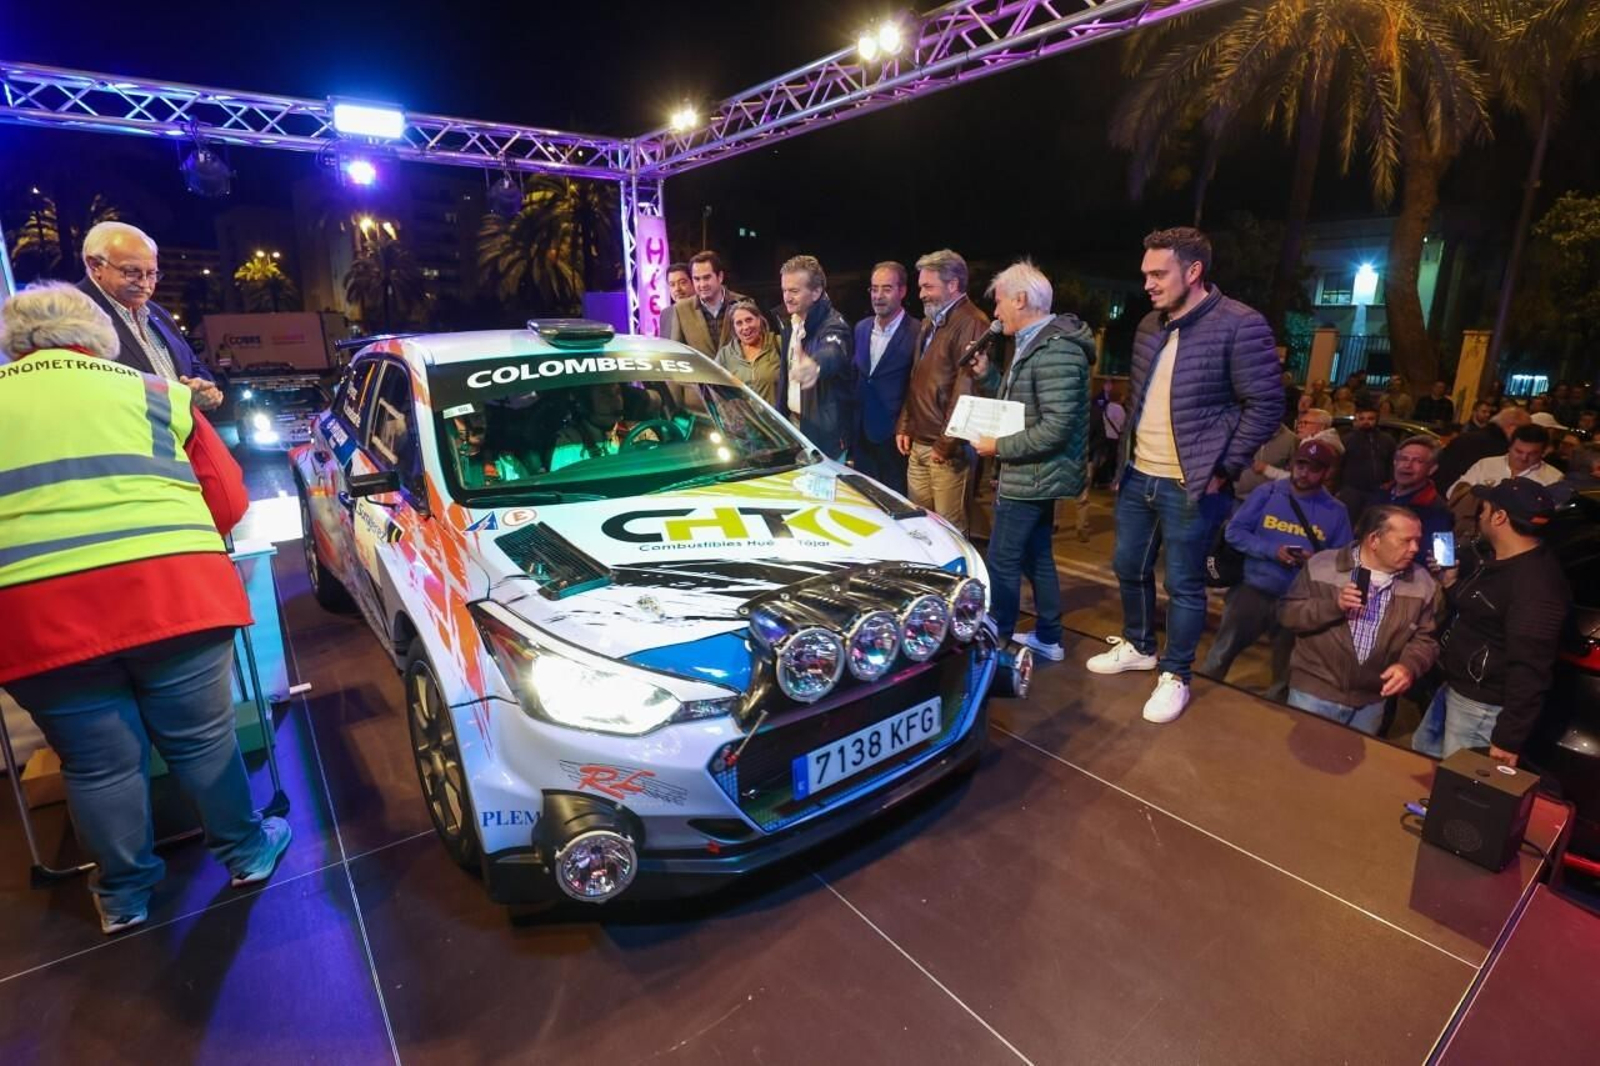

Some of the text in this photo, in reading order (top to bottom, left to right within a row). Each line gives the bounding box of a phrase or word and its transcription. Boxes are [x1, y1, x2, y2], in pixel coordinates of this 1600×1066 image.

[466, 357, 694, 389] COLOMBES.ES
[638, 538, 742, 551] Combustibles
[815, 706, 933, 785] 7138 KFG
